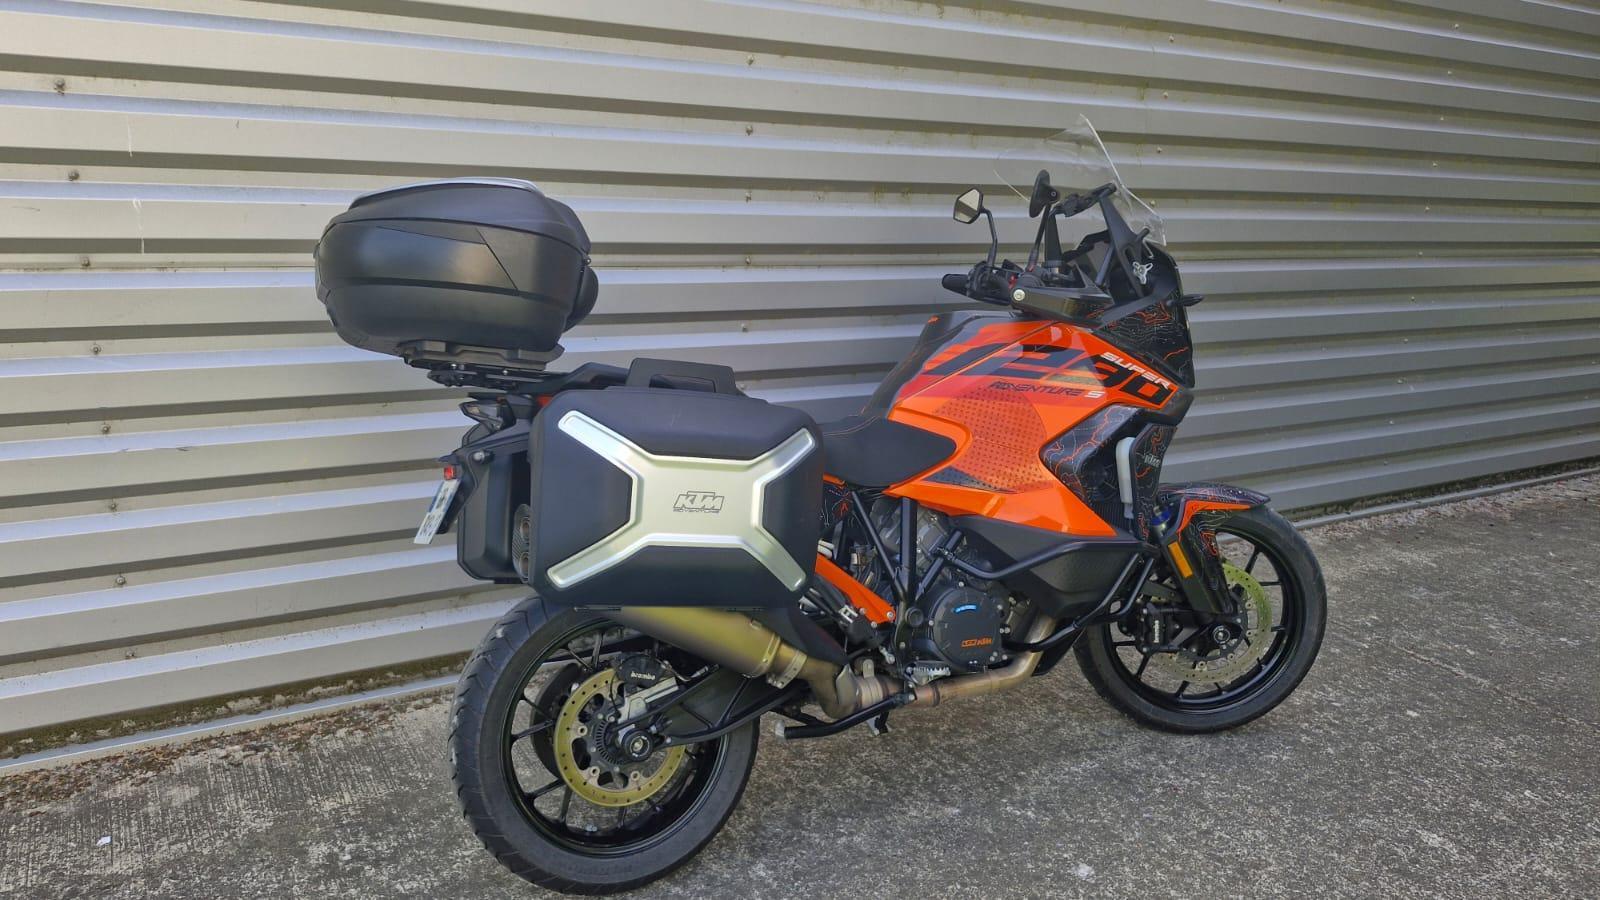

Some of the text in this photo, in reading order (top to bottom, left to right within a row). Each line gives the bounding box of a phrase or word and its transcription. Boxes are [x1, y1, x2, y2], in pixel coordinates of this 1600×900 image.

[1100, 351, 1171, 391] SUPER
[988, 380, 1106, 398] ADVENTURE S
[673, 490, 725, 511] KTM
[630, 670, 656, 681] brembo
